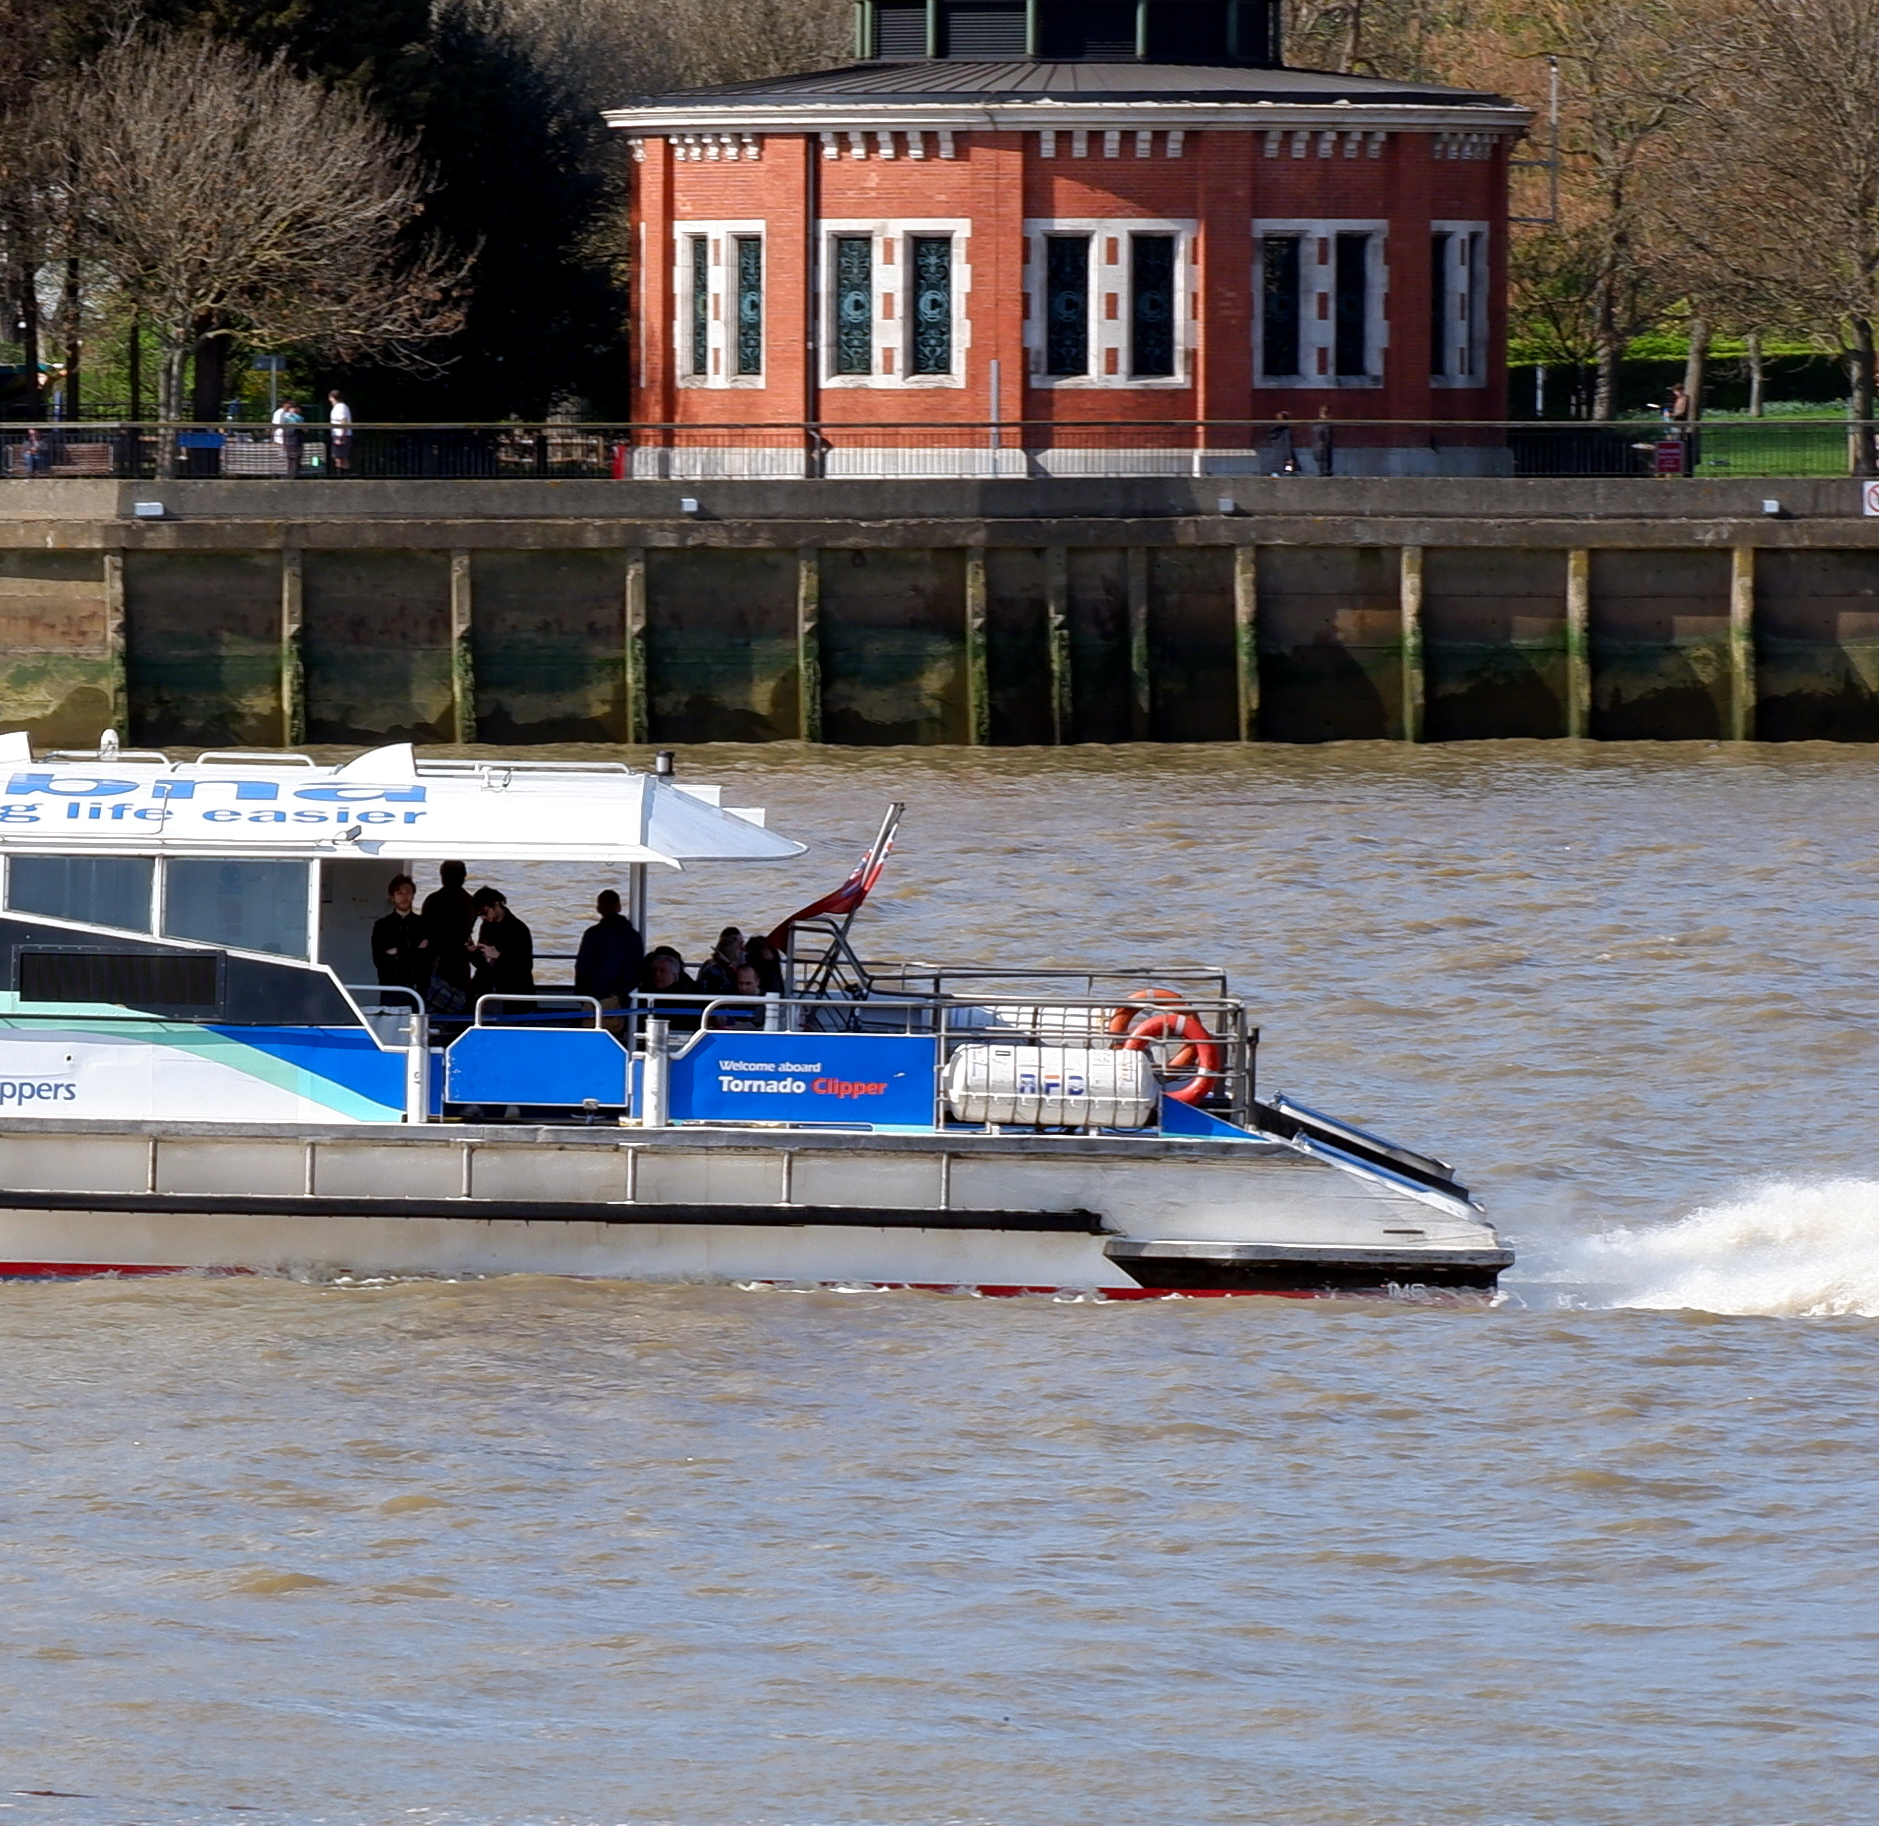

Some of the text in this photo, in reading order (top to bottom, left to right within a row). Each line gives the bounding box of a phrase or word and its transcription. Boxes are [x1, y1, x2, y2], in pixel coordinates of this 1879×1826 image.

[67, 802, 174, 821] life
[202, 807, 427, 824] easier
[719, 1060, 822, 1073] Welcome aboard
[718, 1076, 888, 1099] Tornado Clipper
